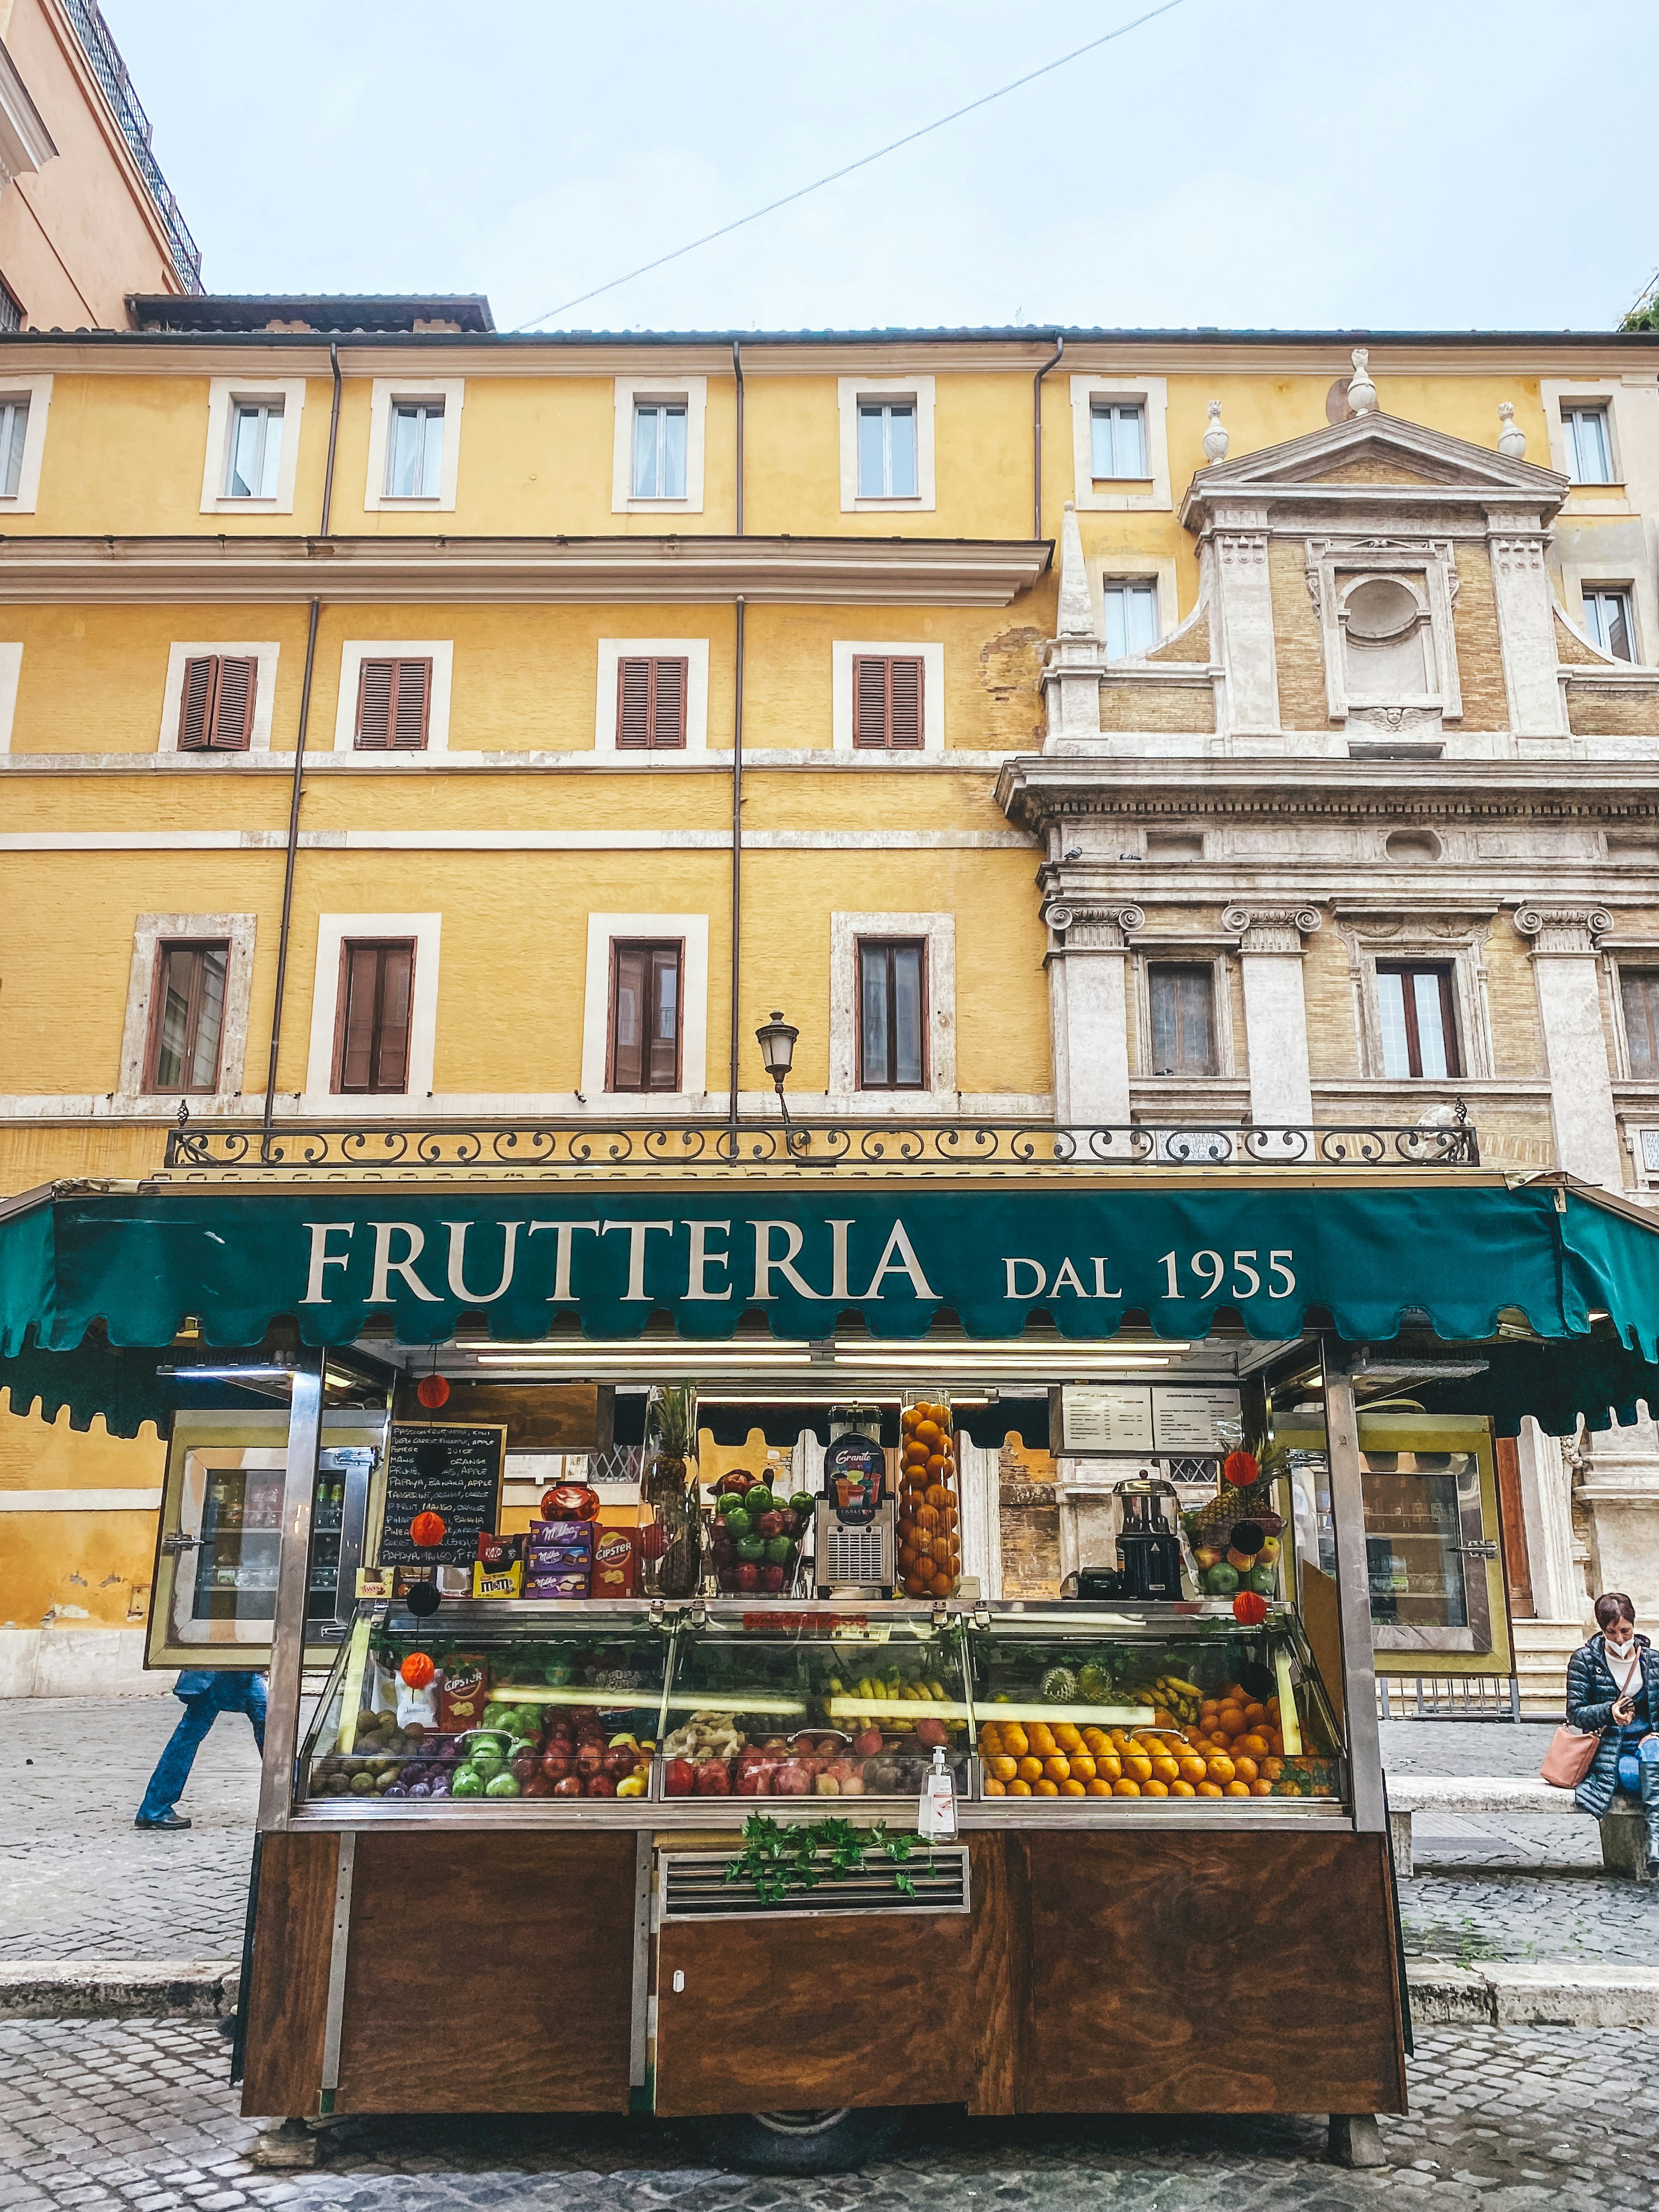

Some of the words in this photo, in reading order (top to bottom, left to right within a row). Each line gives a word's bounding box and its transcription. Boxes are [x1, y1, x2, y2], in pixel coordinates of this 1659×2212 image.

[298, 1219, 943, 1303] FRUTTERIA
[1002, 1257, 1122, 1298] DAL
[1157, 1250, 1296, 1299] 1955
[835, 1450, 879, 1465] Granite
[461, 1466, 488, 1475] APPLE
[389, 1477, 427, 1490] PAPAYA,
[428, 1477, 466, 1490] BANANA,
[542, 1524, 581, 1541] Milka
[538, 1550, 560, 1562] Milka
[595, 1542, 632, 1561] CIPSTER
[535, 1576, 557, 1588] Milka
